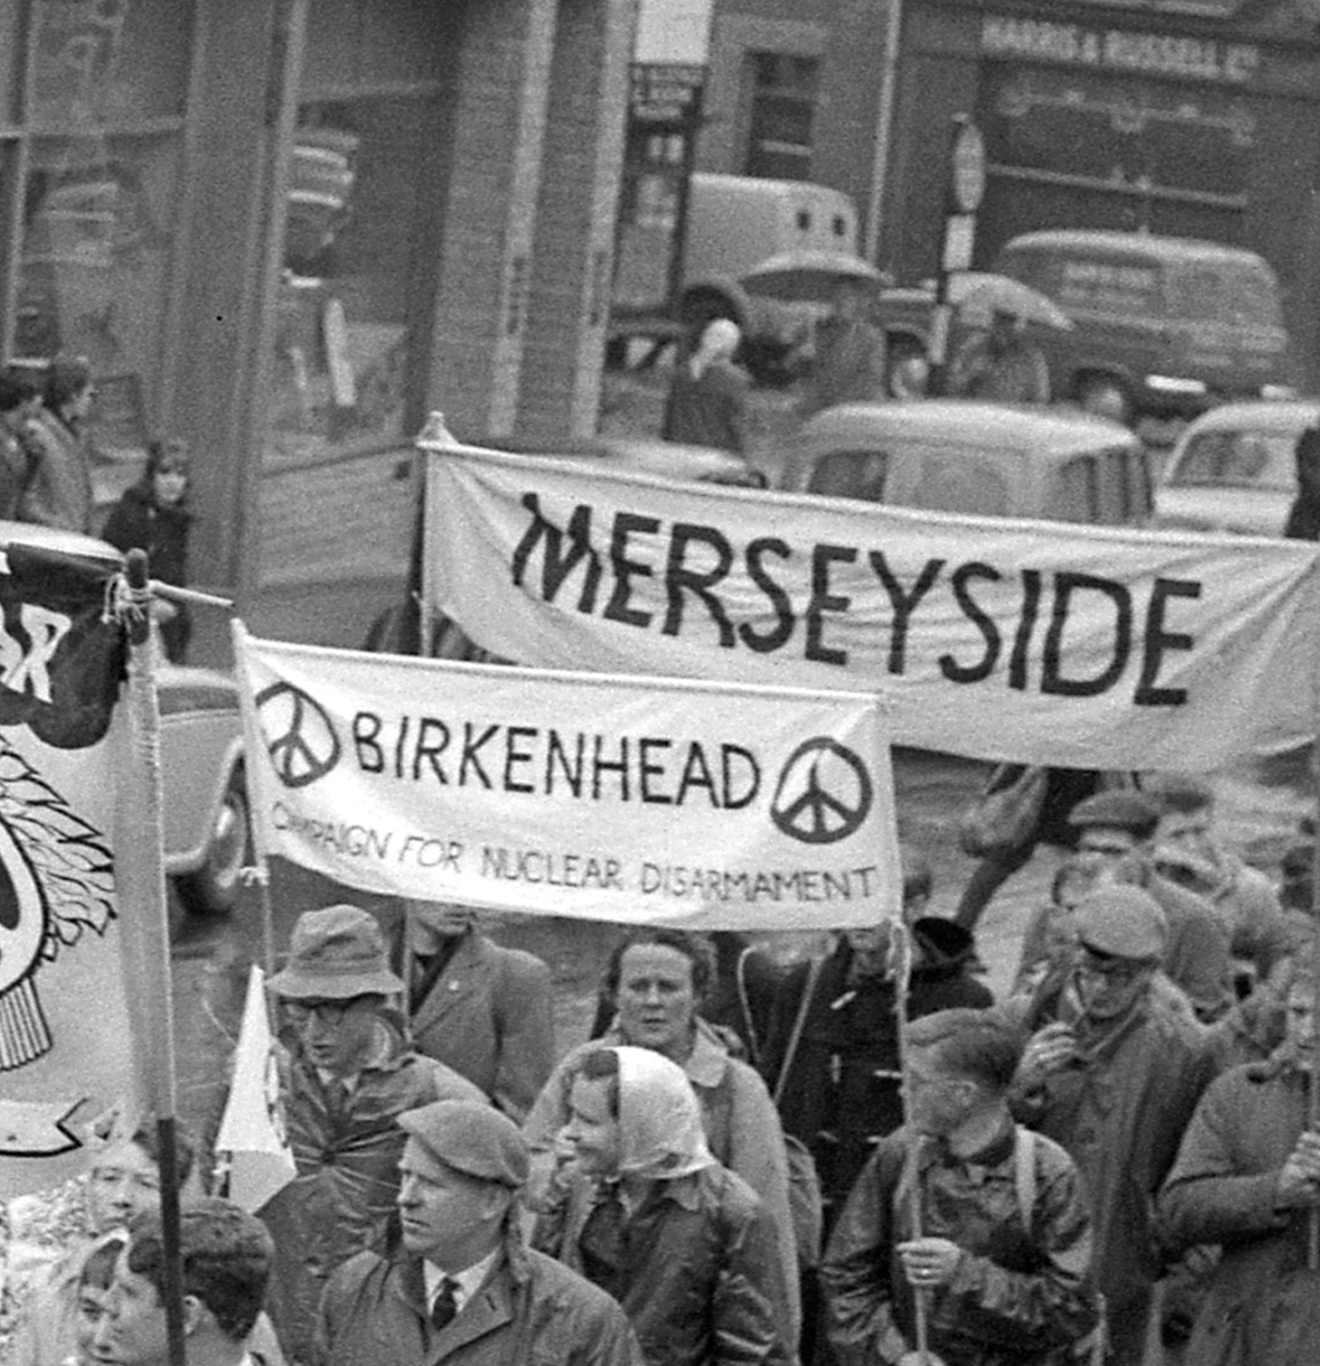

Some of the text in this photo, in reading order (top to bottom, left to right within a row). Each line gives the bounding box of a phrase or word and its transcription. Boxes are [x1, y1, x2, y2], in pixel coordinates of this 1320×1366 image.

[512, 492, 1202, 707] MERSEYSIDE
[351, 709, 761, 813] BIRKENHEAD
[399, 834, 463, 875] FOR
[480, 845, 624, 894] NUCLEAR
[640, 862, 879, 906] DISARMAMENT
